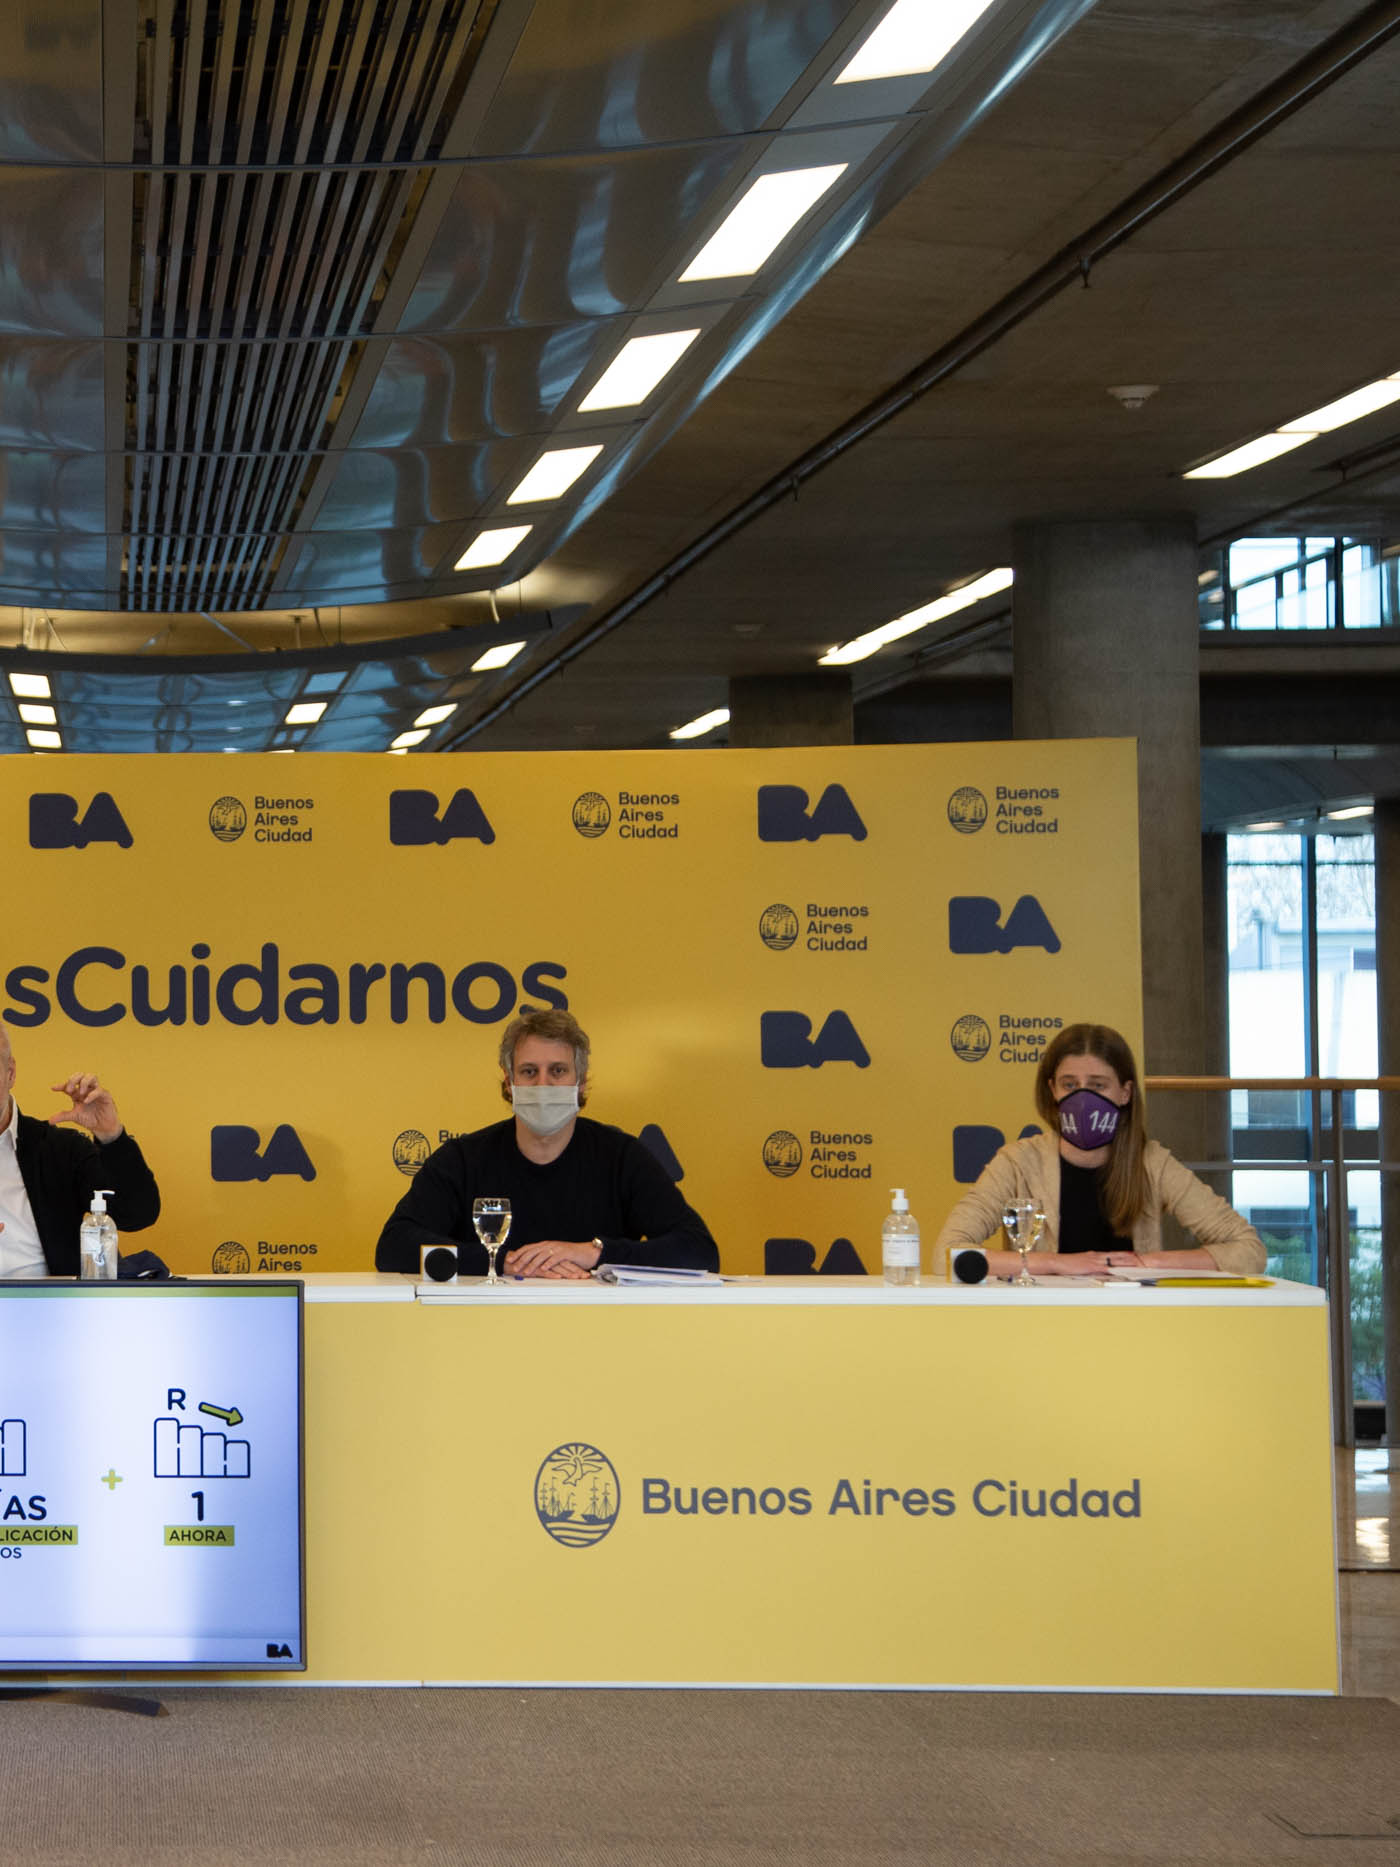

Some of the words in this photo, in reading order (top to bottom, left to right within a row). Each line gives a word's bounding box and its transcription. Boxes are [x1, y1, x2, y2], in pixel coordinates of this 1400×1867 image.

[619, 792, 679, 805] Buenos
[996, 787, 1059, 800] Buenos
[255, 796, 314, 809] Buenos
[390, 788, 495, 846] BA
[619, 809, 663, 821] Aires
[758, 784, 868, 842] BA
[996, 803, 1043, 817] Aires
[29, 792, 133, 849] BA
[255, 813, 298, 826] Aires
[996, 819, 1057, 834] Ciudad
[255, 828, 312, 842] Ciudad
[619, 824, 678, 838] Ciudad
[807, 904, 868, 917] Buenos
[807, 921, 853, 934] Aires
[949, 895, 1061, 954] BA
[807, 936, 867, 951] Ciudad
[1000, 1015, 1063, 1028] Buenos
[761, 1010, 871, 1069] BA
[1000, 1032, 1046, 1045] Aires
[1000, 1048, 1047, 1063] Ciud
[1090, 1110, 1118, 1133] 144
[810, 1131, 872, 1144] Buenos
[211, 1124, 316, 1182] BA
[810, 1148, 856, 1161] Aires
[811, 1164, 871, 1178] Ciudad
[258, 1241, 317, 1254] Buenos
[258, 1258, 302, 1271] Aires
[168, 1389, 186, 1410] R
[643, 1479, 812, 1515] Buenos
[829, 1480, 956, 1516] Aires
[973, 1479, 1141, 1518] Ciudad
[192, 1491, 204, 1521] 1
[169, 1529, 227, 1542] AHORA
